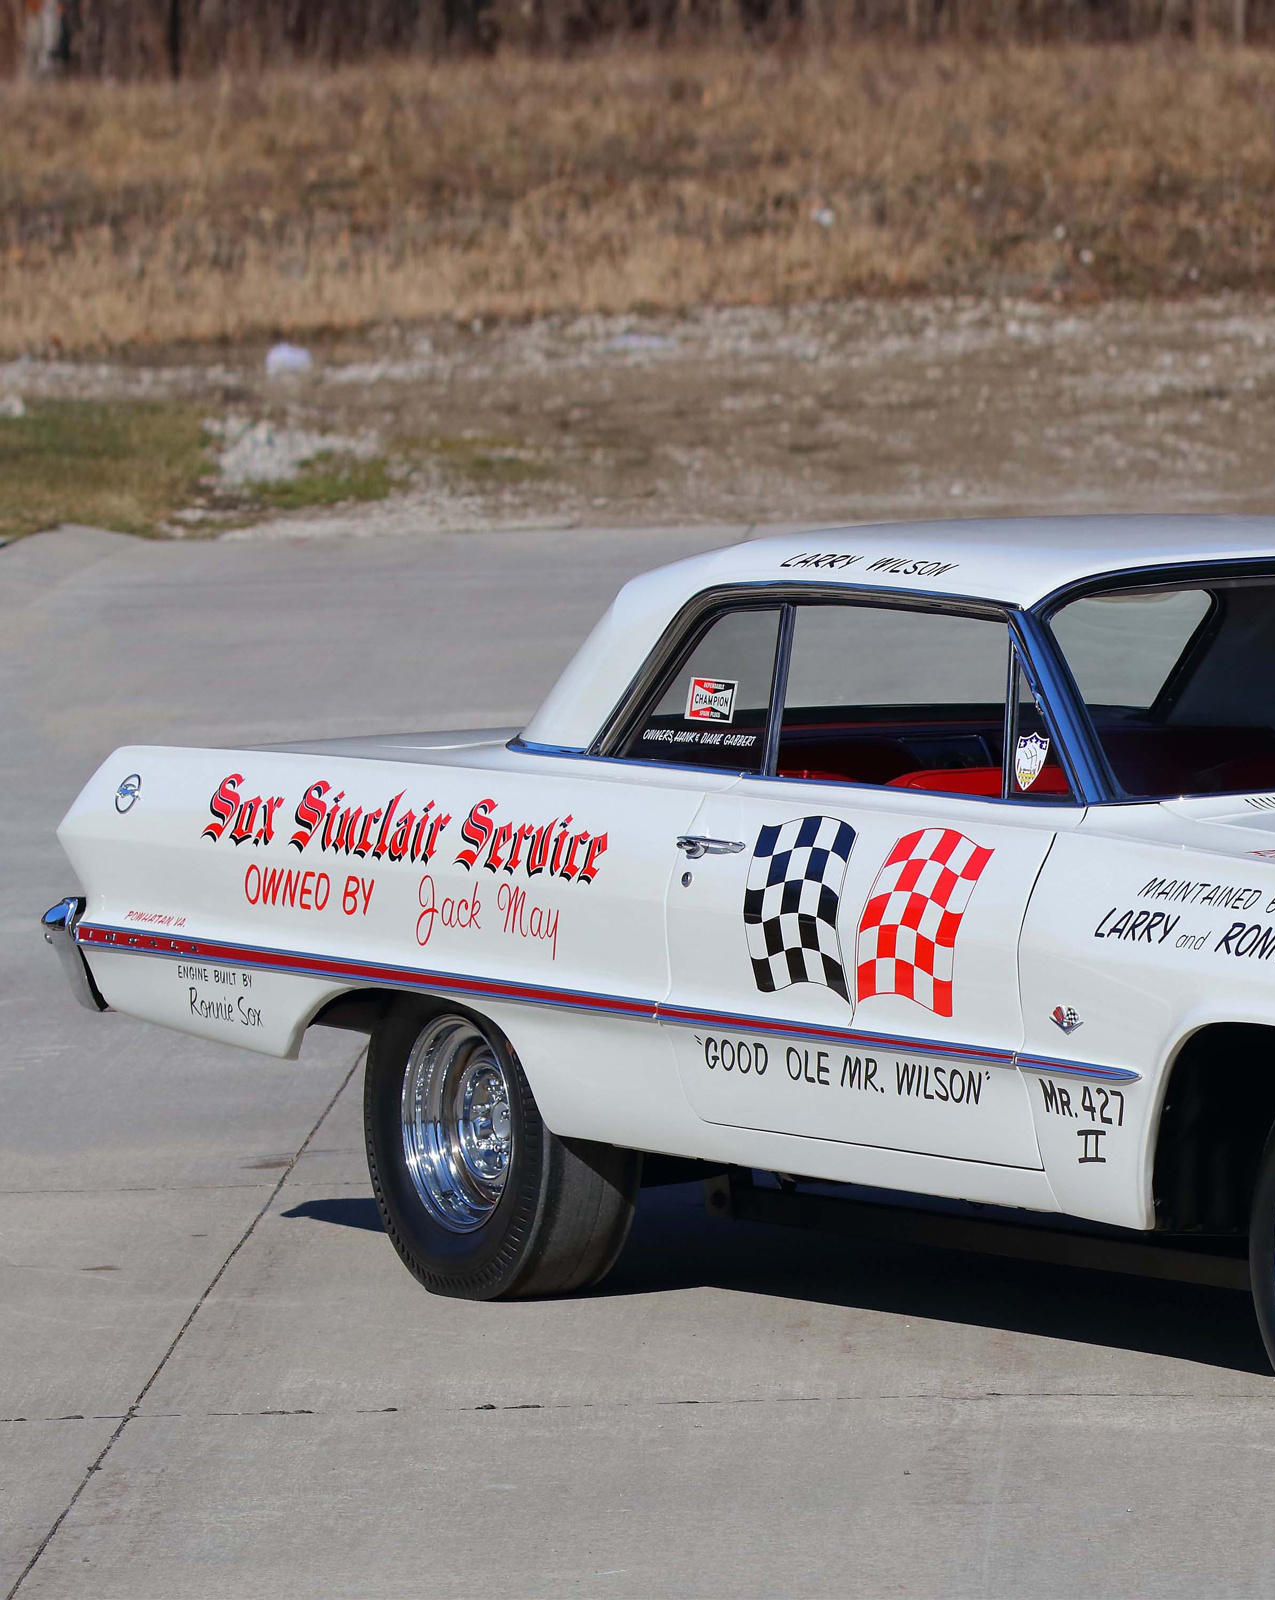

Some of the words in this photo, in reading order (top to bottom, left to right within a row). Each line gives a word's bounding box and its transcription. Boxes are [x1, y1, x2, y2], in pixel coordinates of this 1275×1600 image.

[780, 553, 865, 570] LARRY
[866, 557, 960, 577] WILSON
[694, 693, 730, 707] CHAMPION
[642, 729, 673, 743] OWNERS,
[673, 731, 696, 743] HANK
[700, 733, 725, 745] DIANE
[723, 734, 757, 747] GABBERT
[201, 773, 286, 847] Sox
[288, 780, 452, 866] Sinclair
[454, 798, 610, 885] Service
[1137, 877, 1263, 910] MAINTAINED
[124, 910, 173, 926] POWHATAN
[174, 916, 186, 928] VA.
[244, 864, 331, 912] OWNED
[342, 875, 375, 916] BY
[416, 875, 481, 946] Jack
[497, 883, 560, 961] May
[1094, 908, 1181, 944] LARRY
[1175, 931, 1212, 950] and
[87, 930, 200, 952] IMPALA
[177, 965, 209, 982] ENGINE
[213, 969, 237, 986] BUILT
[242, 973, 253, 988] BY
[188, 986, 235, 1023] Ronnie
[237, 996, 264, 1028] Sox
[786, 1046, 830, 1086] OLE
[840, 1055, 886, 1094] MR.
[1080, 1086, 1125, 1127] 427
[1077, 1129, 1107, 1164] II
